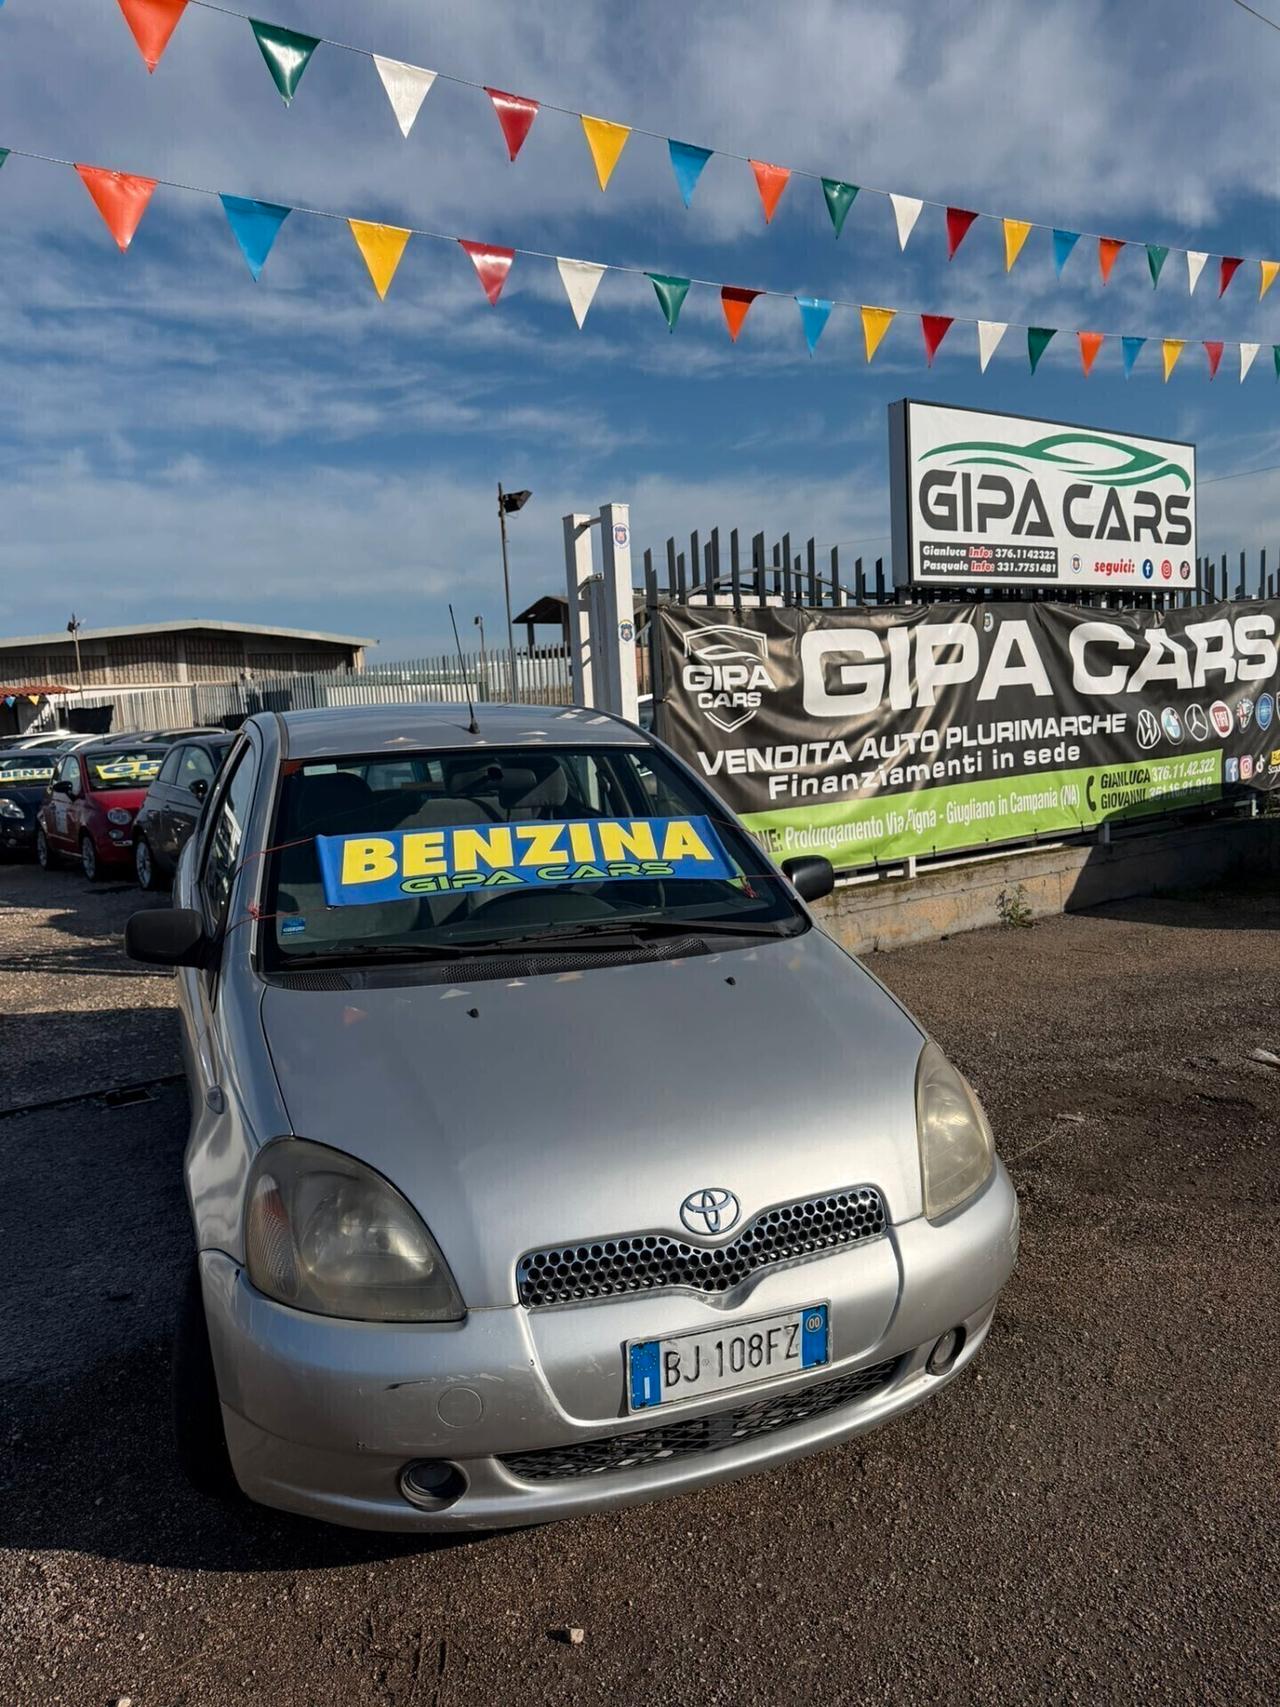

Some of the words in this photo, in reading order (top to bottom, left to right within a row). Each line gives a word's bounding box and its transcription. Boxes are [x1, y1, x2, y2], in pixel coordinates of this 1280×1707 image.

[919, 469, 1055, 538] GIPA
[1062, 483, 1192, 546] CARS
[922, 545, 967, 557] Gianluca
[969, 546, 993, 559] Info:
[995, 548, 1056, 560] 376.1142322
[923, 560, 969, 573] Pasquale
[970, 560, 995, 572] Info:
[996, 562, 1056, 573] 331.7751481
[1094, 559, 1135, 576] seguici:
[682, 664, 777, 692] GIPA
[800, 620, 1054, 718] GIPA
[1068, 615, 1279, 695] CARS
[697, 692, 762, 709] CARS
[697, 739, 853, 776] VENDITA
[858, 730, 939, 761] AUTO
[946, 713, 1127, 750] PLURIMARCHE
[768, 751, 983, 800] Finanziamenti
[992, 749, 1014, 770] in
[1023, 741, 1081, 766] sede
[1101, 768, 1151, 789] GIANLUCA
[1151, 757, 1216, 782] 376.11.42.322
[1101, 787, 1147, 810] GIOVANNI
[784, 819, 884, 851] Prolungamento
[885, 810, 904, 836] Via
[946, 798, 996, 826] Giugliano
[998, 794, 1008, 816] in
[1010, 787, 1058, 814] Campania
[1060, 784, 1080, 809] (NA)
[341, 820, 715, 886] BENZINA
[400, 869, 528, 894] GIPA
[536, 861, 675, 881] CARS
[663, 1345, 701, 1388] BJ
[715, 1322, 800, 1378] 108FZ
